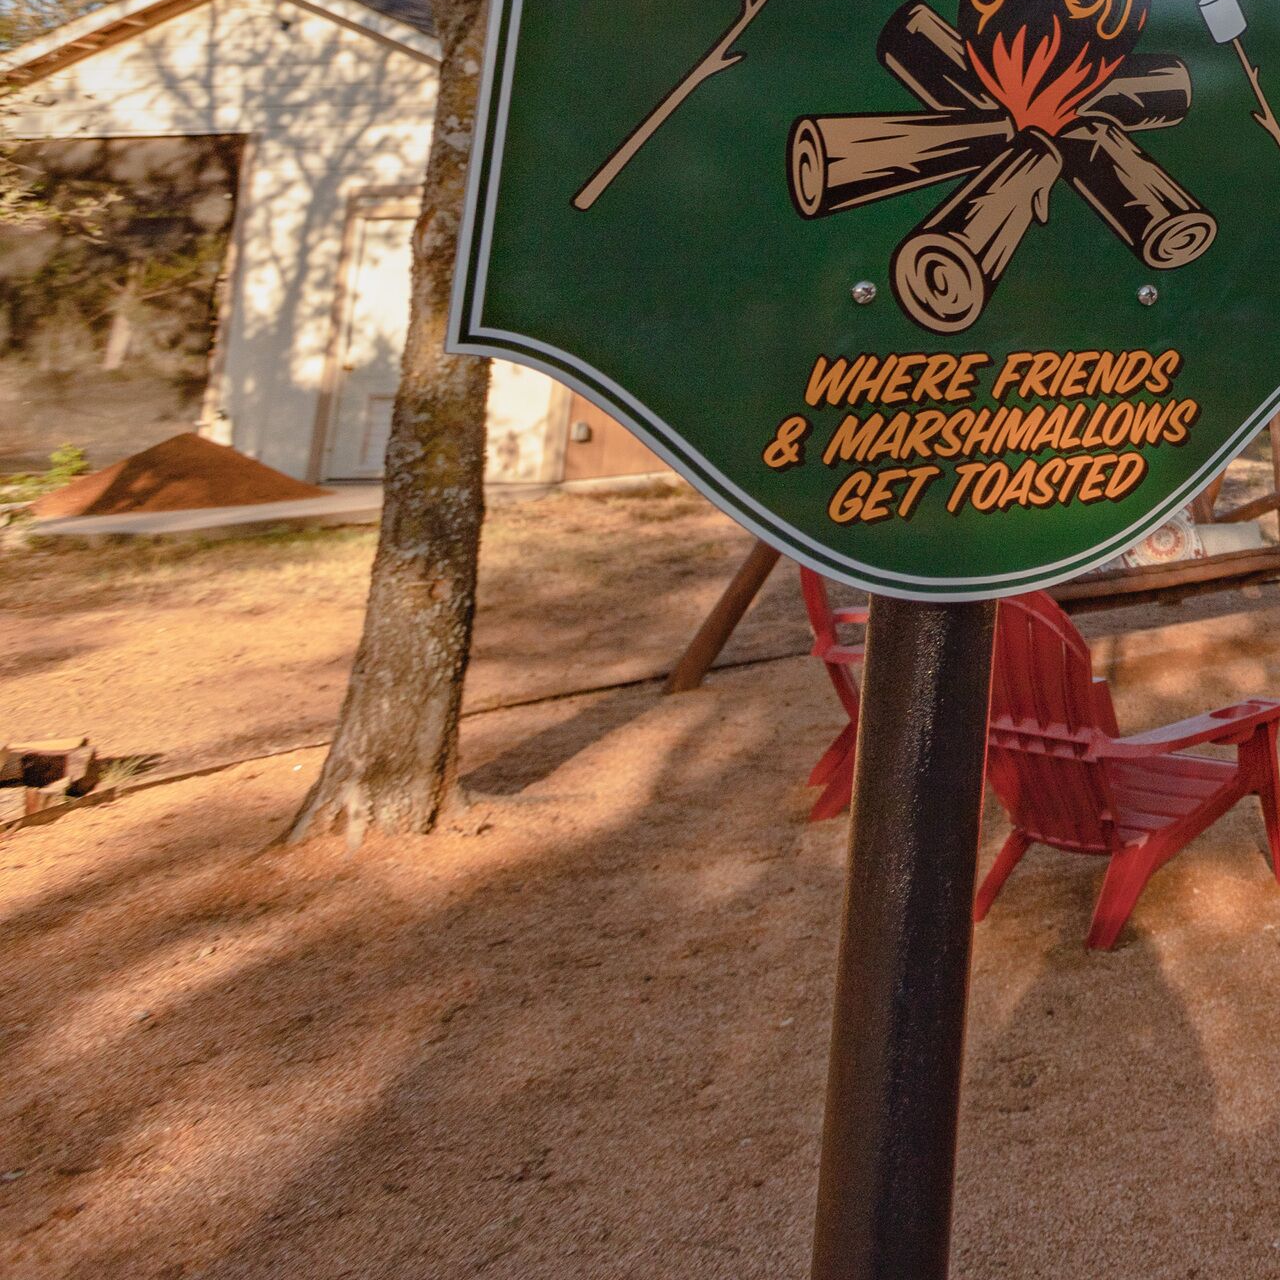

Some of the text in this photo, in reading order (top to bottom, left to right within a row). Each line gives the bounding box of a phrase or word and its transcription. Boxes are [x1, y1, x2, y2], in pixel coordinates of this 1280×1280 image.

[804, 349, 1180, 407] WHERE FRIENDS
[762, 398, 1198, 469] & MARSHMALLOWS
[828, 451, 1146, 524] GET TOASTED
